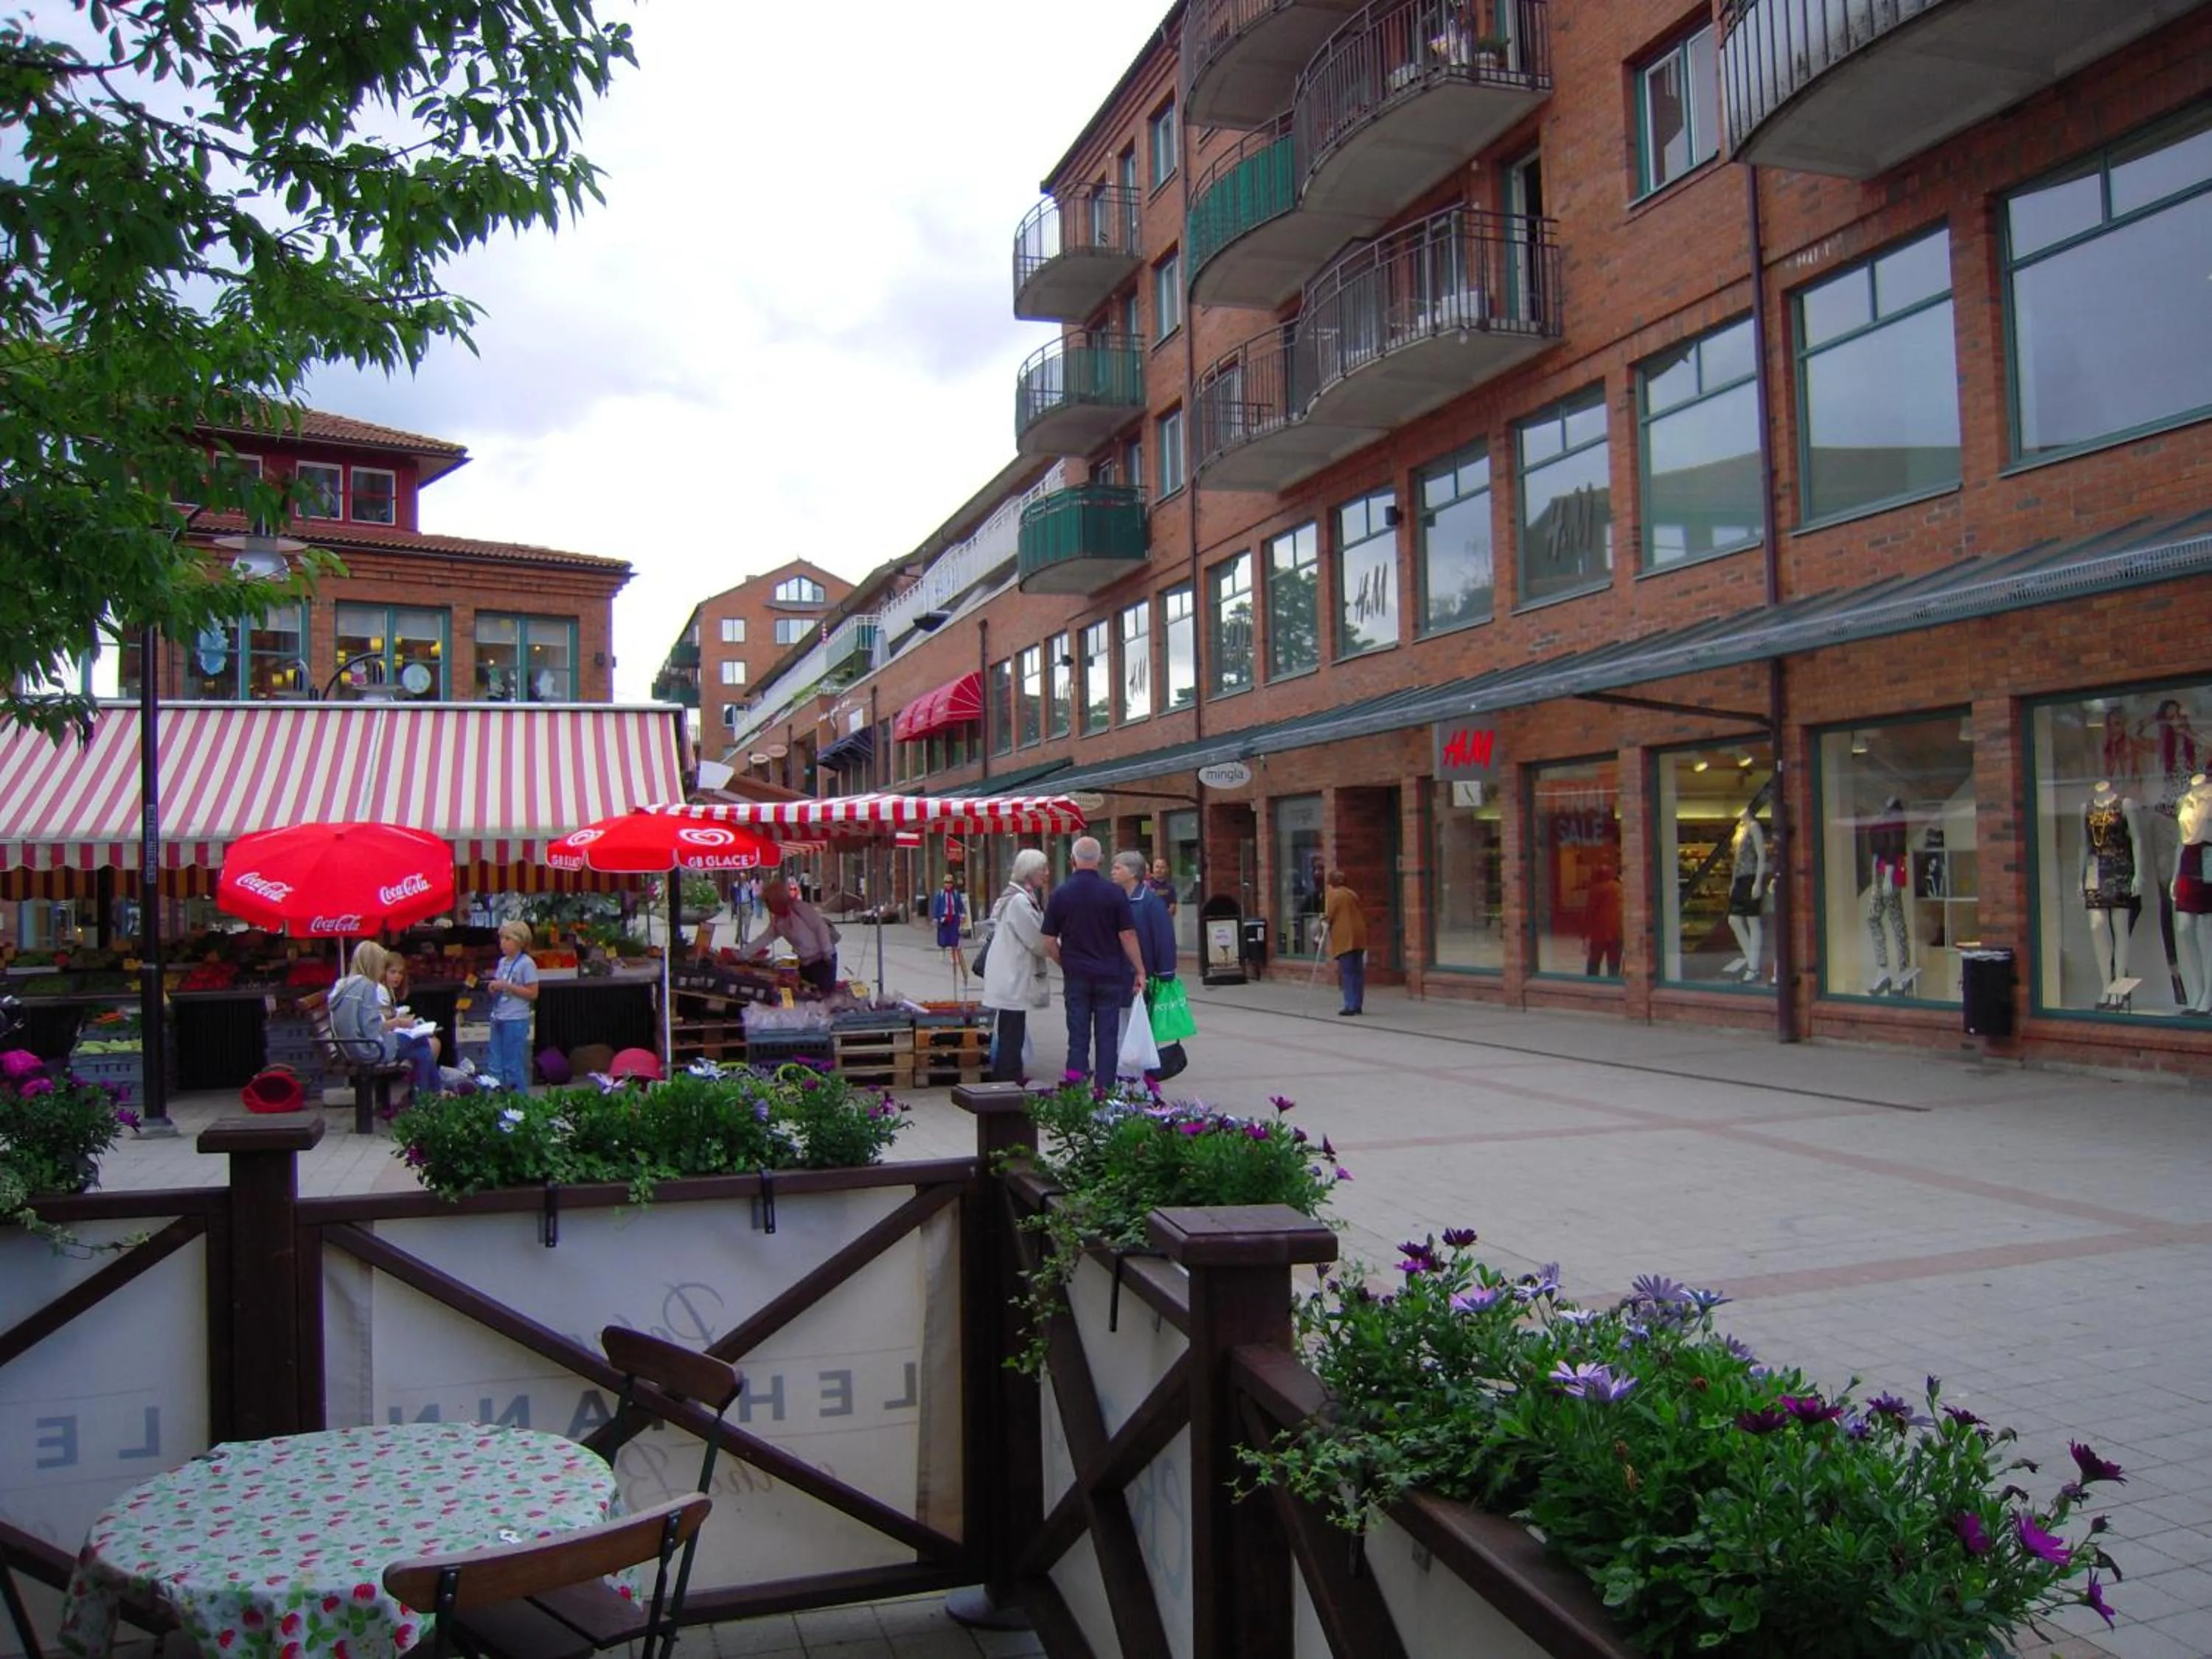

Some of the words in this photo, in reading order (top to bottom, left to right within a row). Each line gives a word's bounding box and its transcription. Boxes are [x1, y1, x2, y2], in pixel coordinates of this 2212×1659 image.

[1206, 766, 1245, 782] mingla
[1557, 818, 1604, 846] SALE
[688, 856, 703, 868] GB
[706, 855, 748, 867] GLACE
[235, 872, 293, 902] Coca-Cola
[378, 872, 432, 905] Coca-Cola
[310, 914, 362, 933] Coca-Cola
